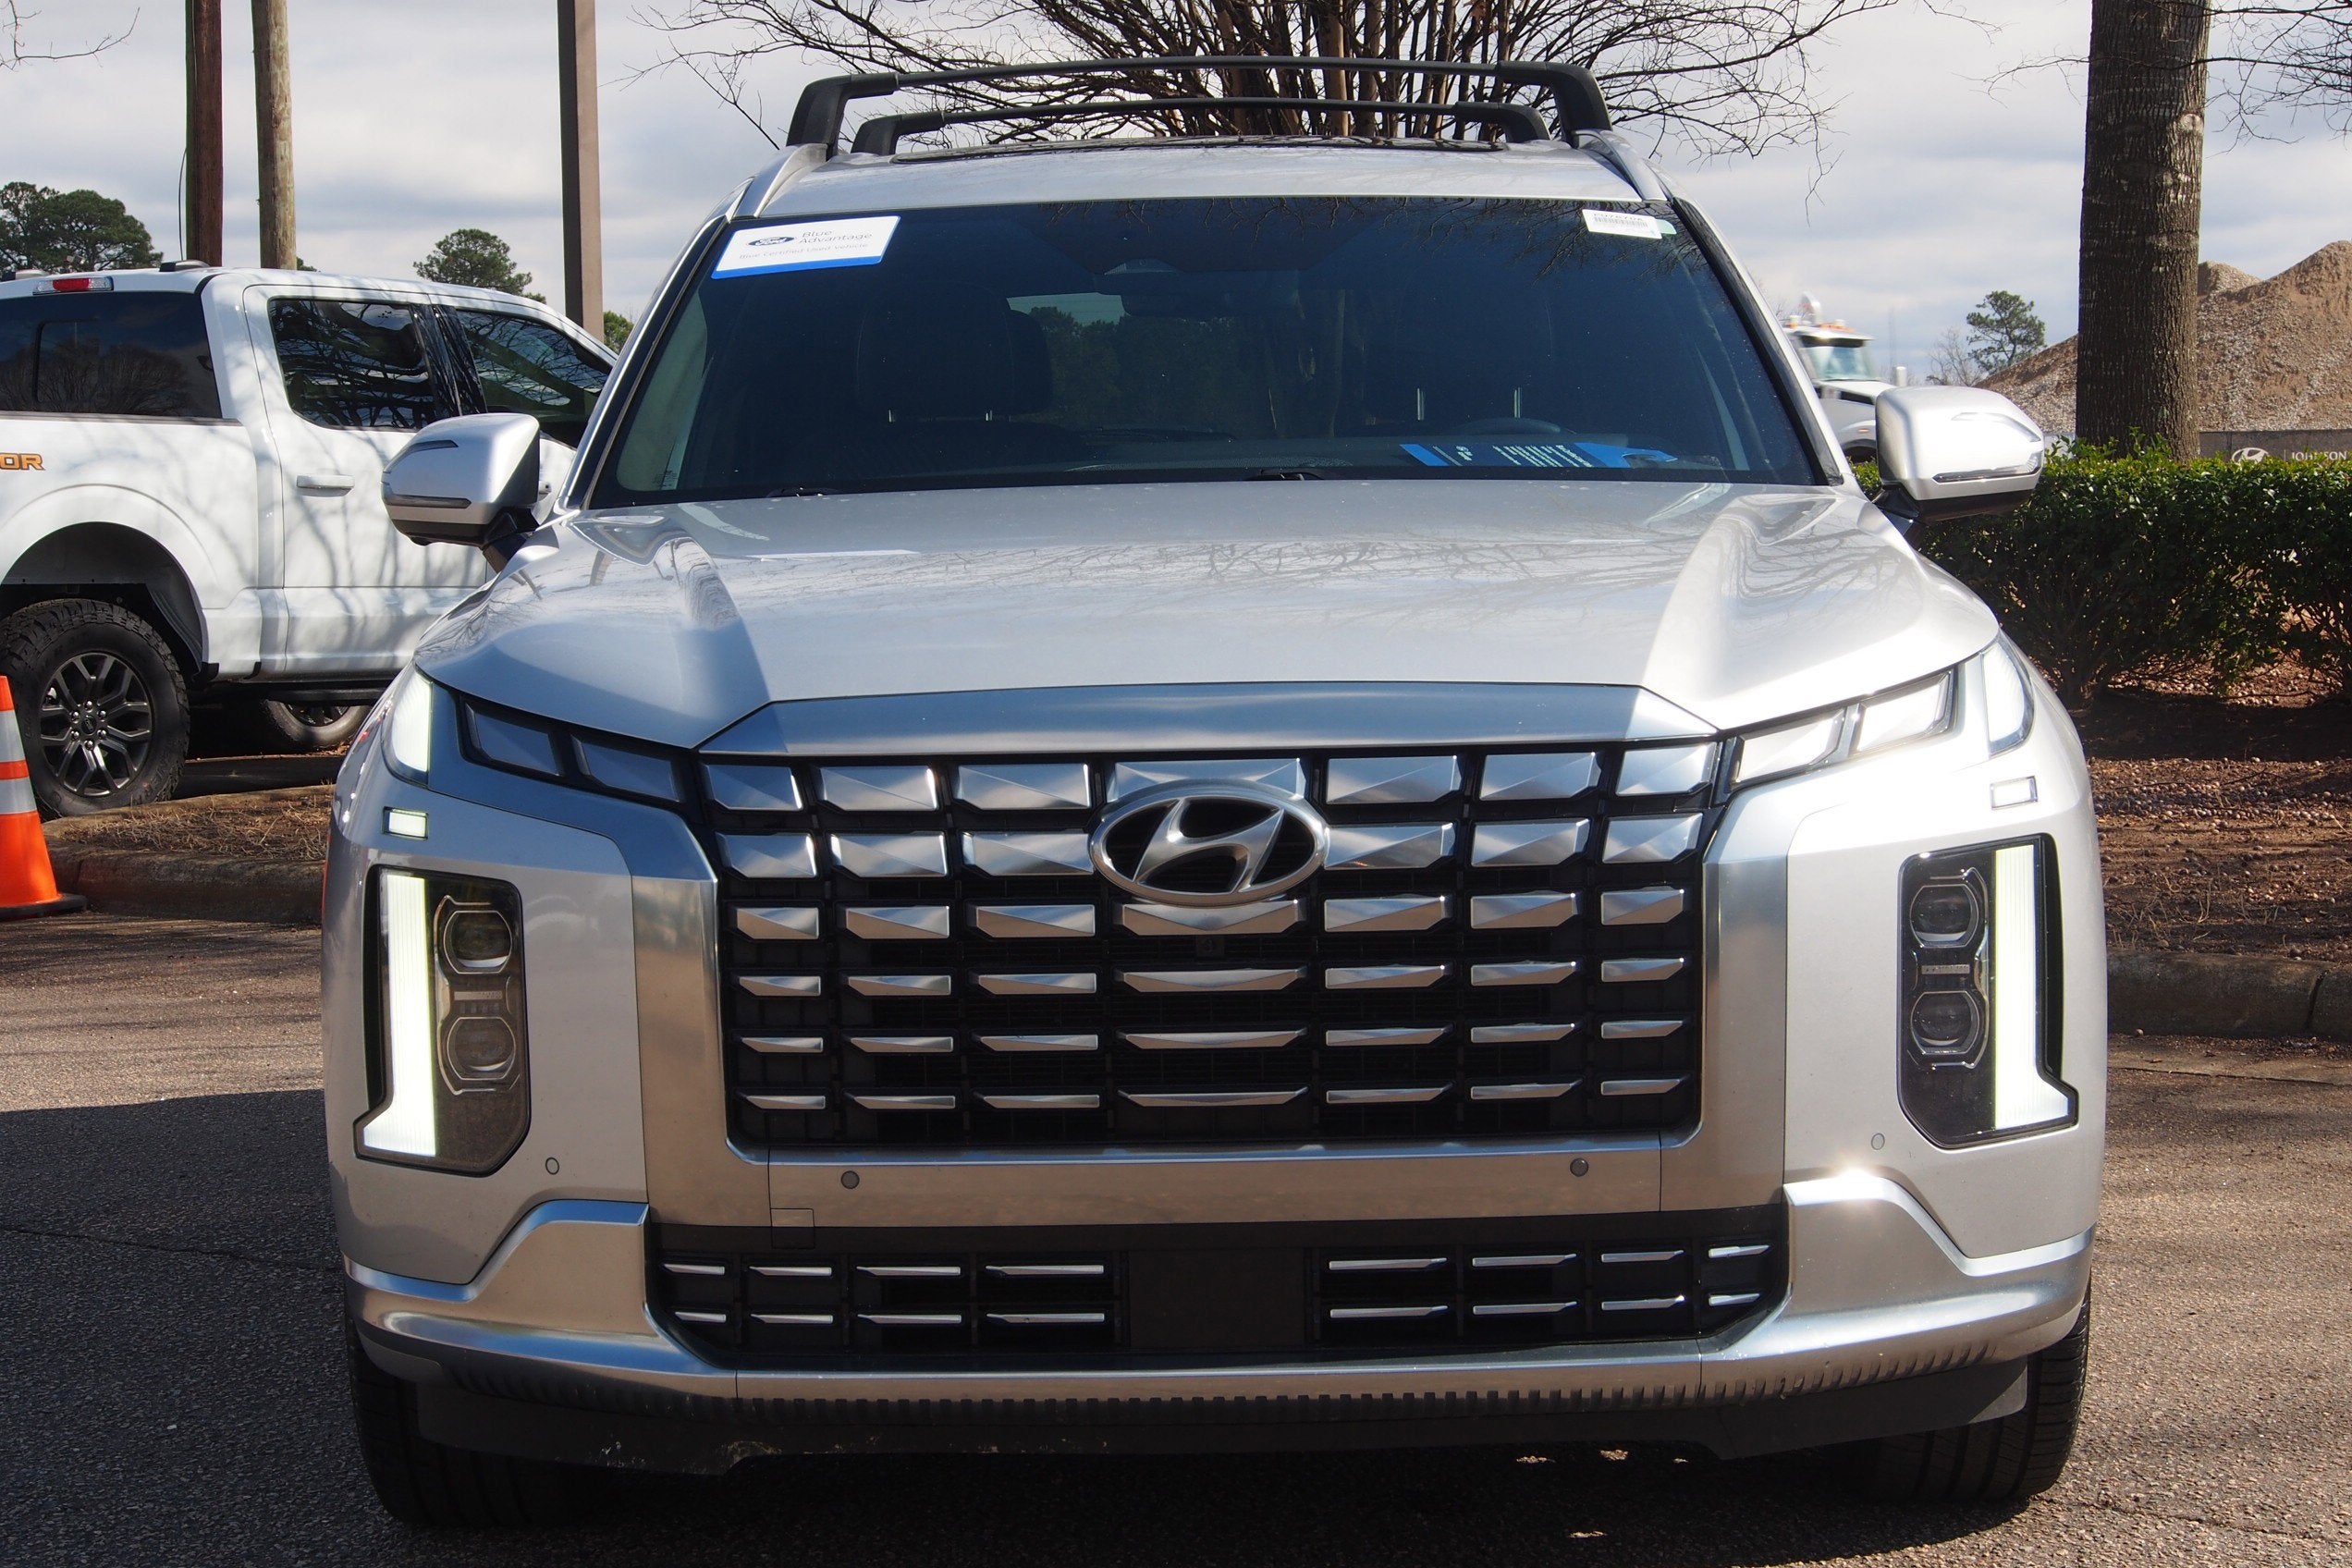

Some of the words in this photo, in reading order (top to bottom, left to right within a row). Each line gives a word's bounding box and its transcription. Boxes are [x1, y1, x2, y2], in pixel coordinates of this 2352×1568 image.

[799, 233, 872, 244] Advantage
[0, 452, 45, 471] OR
[2291, 451, 2347, 461] JOHON
